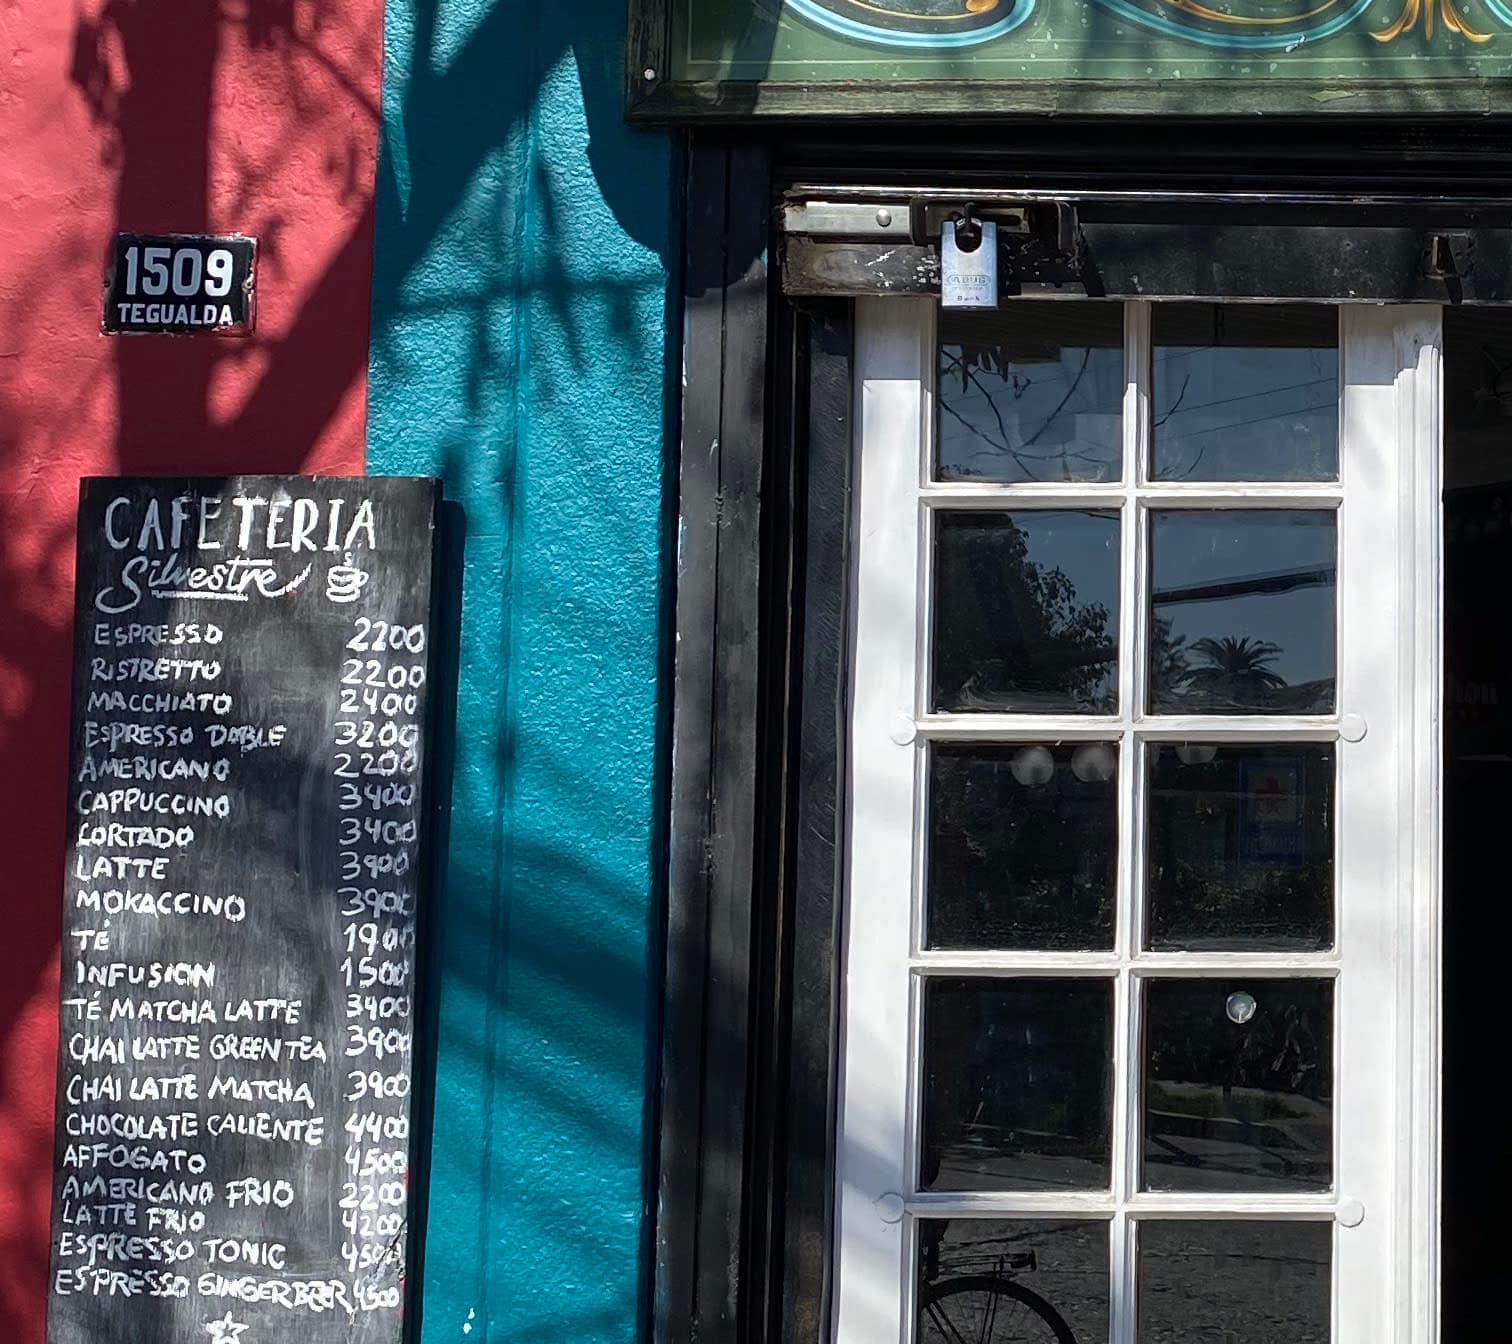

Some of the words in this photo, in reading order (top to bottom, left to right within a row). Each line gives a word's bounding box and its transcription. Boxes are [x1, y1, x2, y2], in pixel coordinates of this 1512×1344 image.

[125, 247, 233, 296] 1509
[118, 304, 233, 325] TEGUALDA
[104, 497, 376, 552] CAFETERIA
[95, 554, 311, 614] Silvestre
[94, 623, 223, 646] ESPRESSO
[346, 616, 424, 654] 2200
[89, 658, 221, 683] RISTRETTO
[340, 659, 426, 688] 2200
[88, 690, 233, 715] MACCHIATO
[340, 688, 417, 716] 2400
[85, 721, 193, 752] ESPRESSO
[335, 720, 418, 748] 3200
[79, 758, 230, 782] AMERICANO
[334, 751, 417, 778] 2200
[77, 790, 230, 818] CAPPUCCINO
[339, 782, 416, 810] 3400
[77, 824, 194, 848] CORTADO
[339, 817, 416, 845] 3400
[75, 855, 170, 881] LATTE
[340, 852, 409, 880] 3900
[76, 890, 245, 922] MOKACCINO
[75, 961, 215, 988] INFUSION
[340, 956, 408, 988] 1500
[63, 992, 102, 1022] TÉ
[110, 1001, 217, 1025] MATCHA
[224, 998, 301, 1024] LATTE
[347, 994, 411, 1021] 3400
[70, 1033, 125, 1065] CHAI
[132, 1034, 201, 1060] LATTE
[209, 1034, 281, 1062] GREEN
[285, 1037, 327, 1062] TEA
[345, 1025, 412, 1060] 3900
[67, 1074, 122, 1105] CHAI
[130, 1074, 199, 1101] LATTE
[208, 1077, 315, 1108] MATCHA
[343, 1071, 411, 1101] 3900
[66, 1112, 199, 1139] CHOCOLATE
[206, 1113, 324, 1145] CALIENTE
[345, 1112, 408, 1142] 4400
[63, 1144, 207, 1175] AFFOGATO
[345, 1145, 408, 1176] 4500
[61, 1176, 214, 1202] AMERICANO
[225, 1180, 295, 1208] FRIO
[339, 1182, 406, 1210] 2200
[63, 1201, 136, 1224] LATTE
[146, 1207, 206, 1233] FRIO
[342, 1210, 407, 1238] 4200
[59, 1233, 194, 1262] ESPRESSO
[202, 1238, 286, 1269] TONIC
[54, 1269, 190, 1298] ESPRESSO
[353, 1280, 399, 1311] 4500
